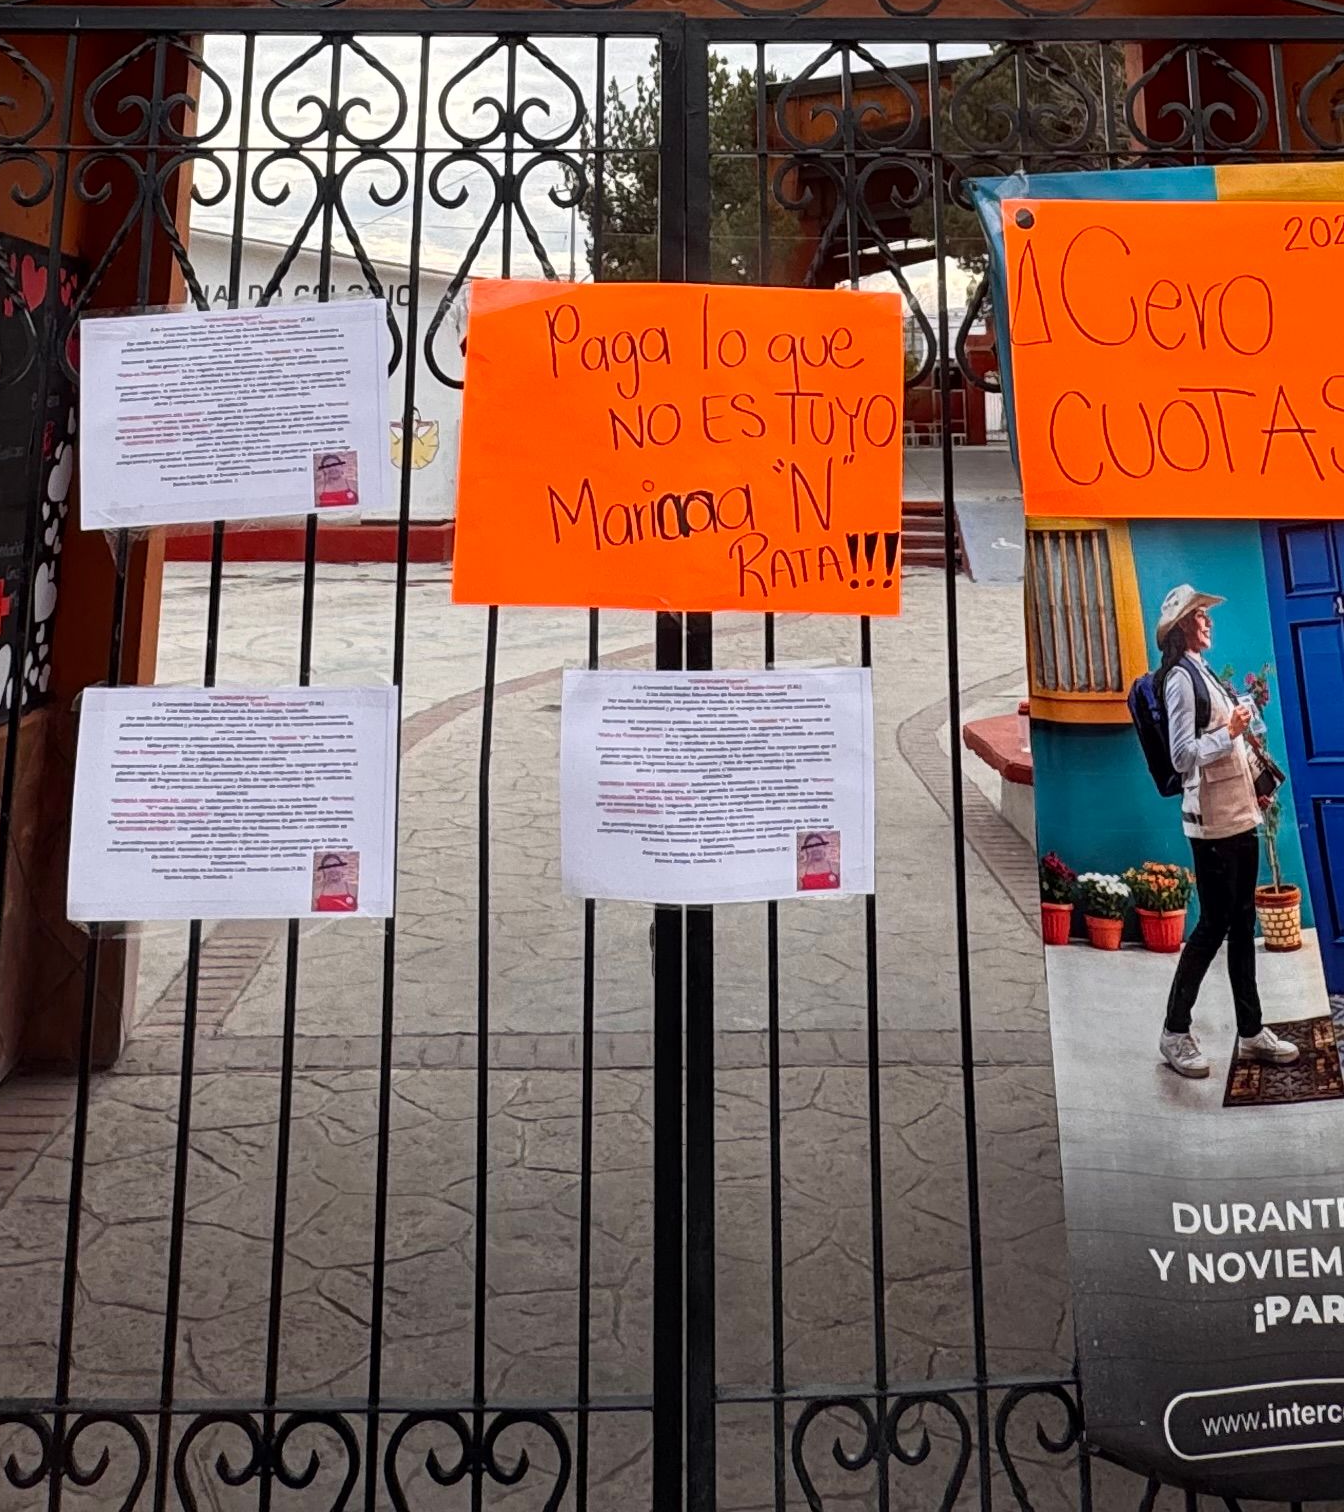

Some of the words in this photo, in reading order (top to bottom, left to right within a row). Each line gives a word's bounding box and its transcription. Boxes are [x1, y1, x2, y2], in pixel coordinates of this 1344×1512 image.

[544, 303, 672, 400] Paga
[701, 292, 748, 371] lo
[766, 326, 866, 394] que
[608, 402, 682, 451] NO
[701, 392, 767, 444] ES
[774, 391, 898, 452] TUYO
[728, 531, 900, 598] RATA!!!
[1148, 1248, 1176, 1283] Y
